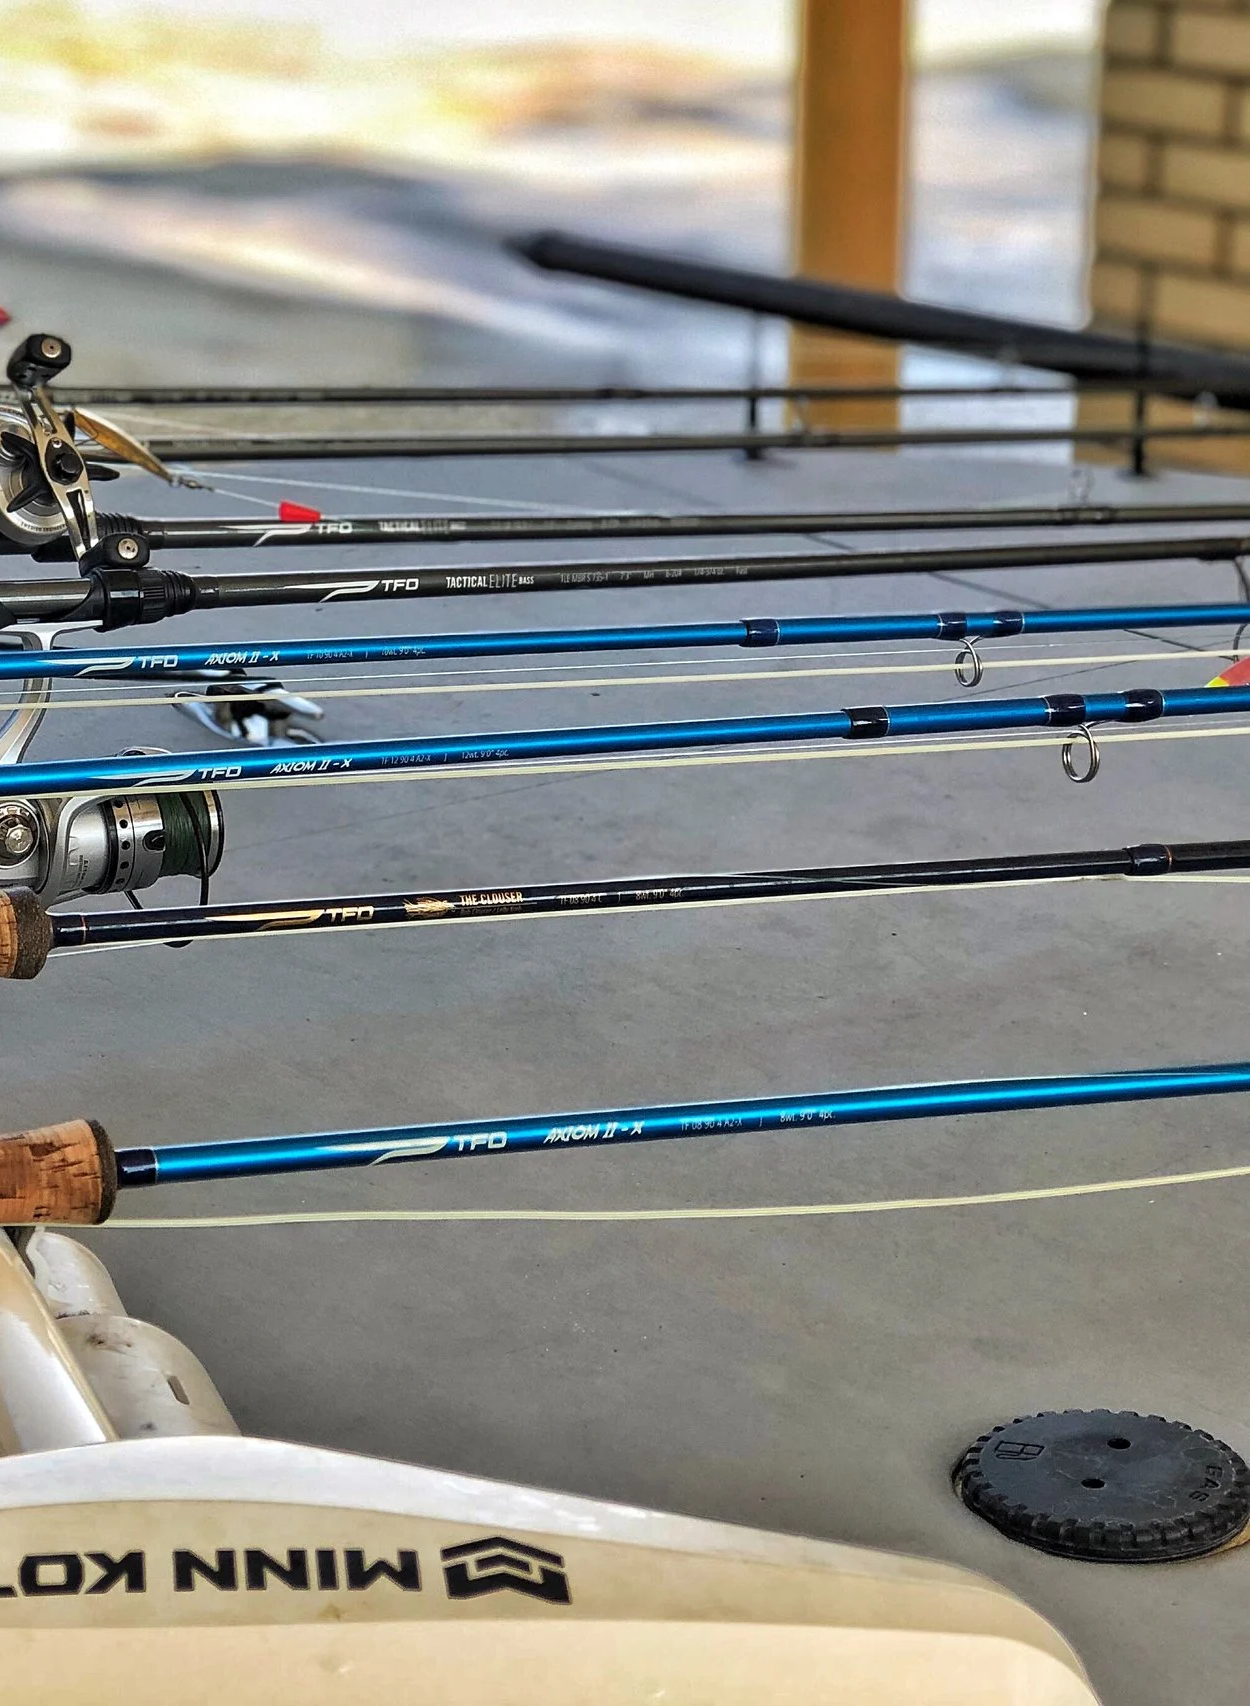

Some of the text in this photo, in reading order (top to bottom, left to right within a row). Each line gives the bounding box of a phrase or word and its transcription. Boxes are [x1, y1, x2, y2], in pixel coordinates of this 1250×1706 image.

[317, 522, 353, 534] TFO
[381, 578, 420, 592] TFO
[446, 573, 535, 589] TACTICAL ELITE BASS
[137, 654, 179, 669] TFO
[205, 652, 247, 666] AXIOM
[198, 765, 242, 779] TFO
[270, 760, 317, 775] AXIOM
[459, 891, 523, 906] THE CLOUSER
[325, 905, 375, 922] TFO
[453, 1131, 508, 1151] TFO
[543, 1123, 600, 1144] AXIOM
[172, 1547, 423, 1593] MINN
